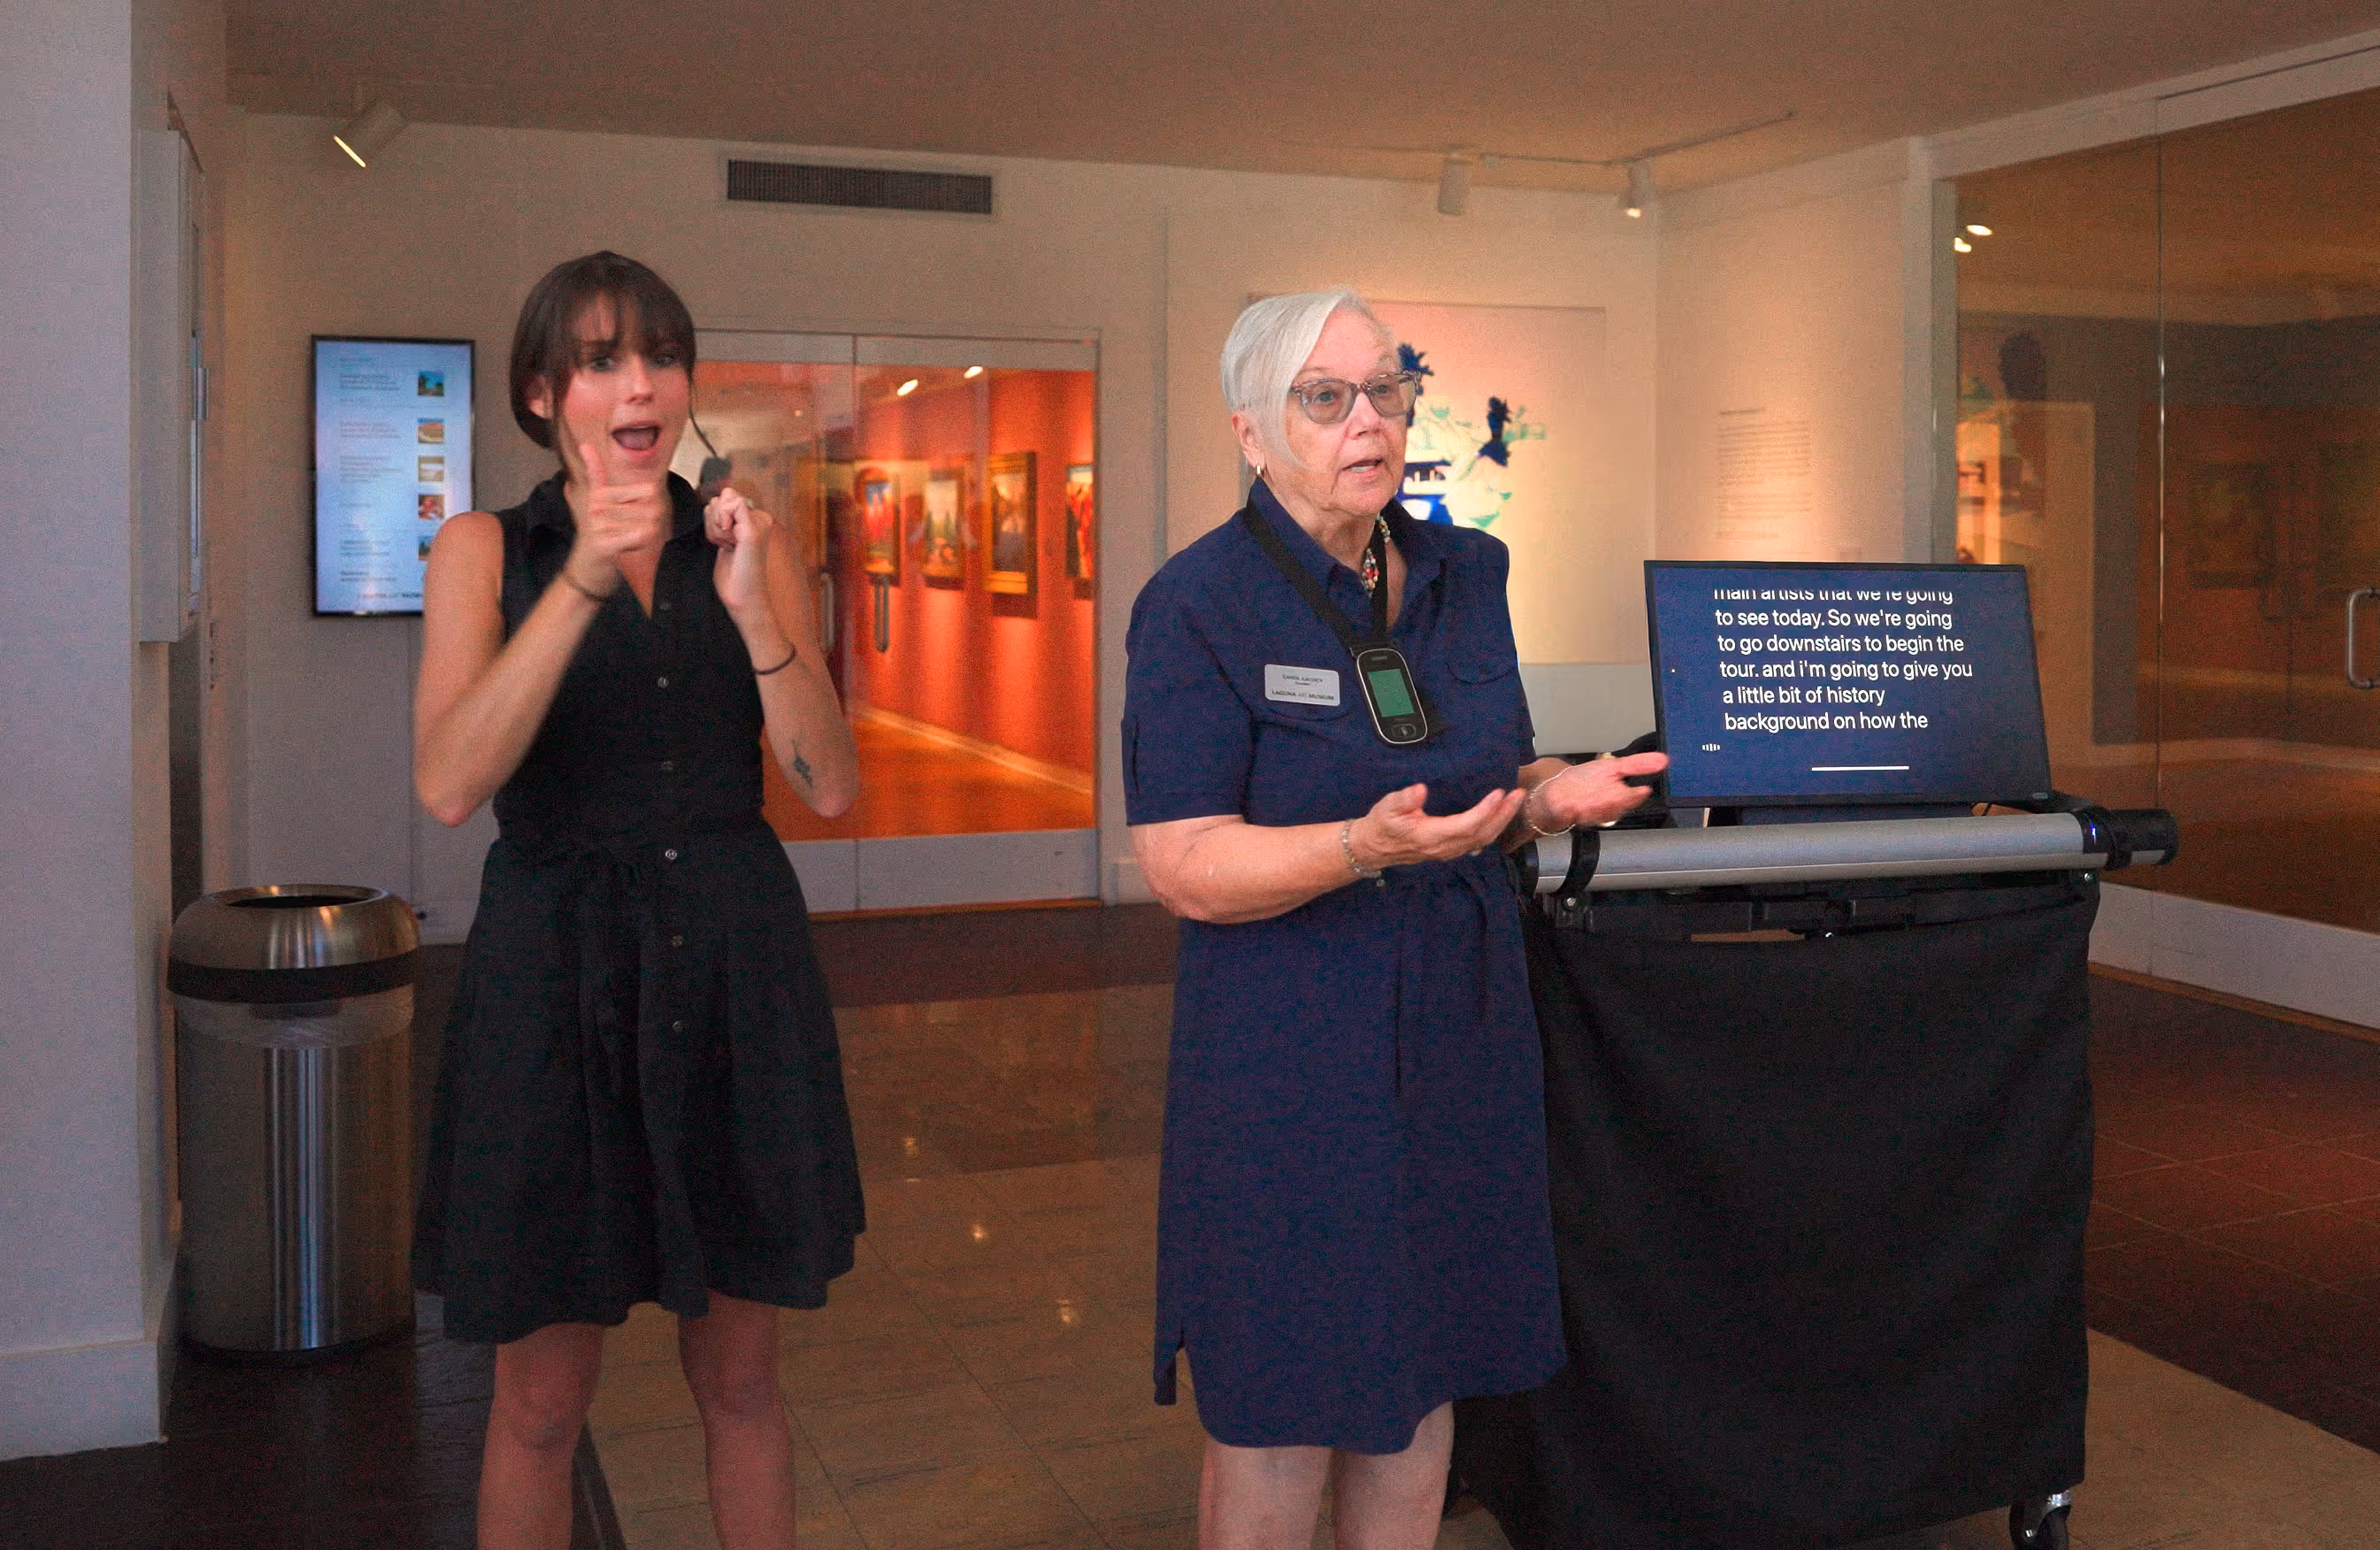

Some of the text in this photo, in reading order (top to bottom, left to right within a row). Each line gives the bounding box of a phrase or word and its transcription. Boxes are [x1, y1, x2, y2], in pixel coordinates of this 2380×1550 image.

[1856, 590, 1902, 602] were
[1715, 608, 1953, 631] to see today. So we're going
[1716, 633, 1964, 656] to go downstairs to begin the
[1719, 659, 1973, 681] tour. and i'm going to give you
[1723, 686, 1885, 707] a little bit of history
[1724, 710, 1929, 734] background on how the
